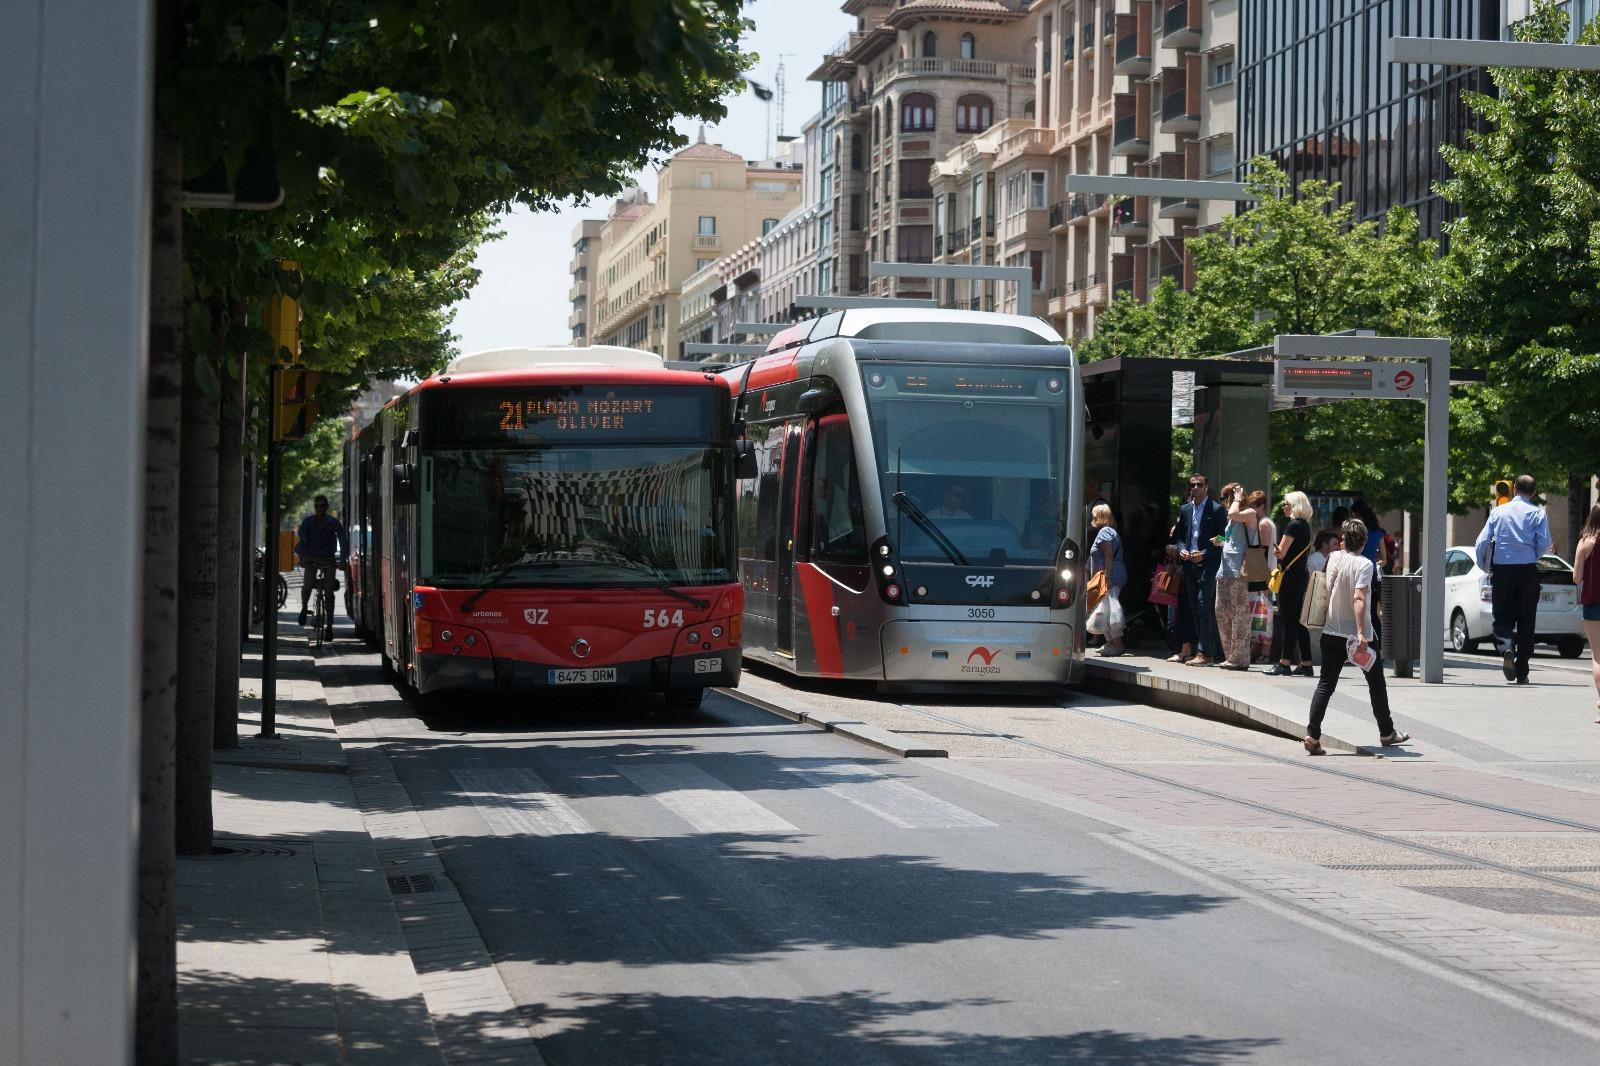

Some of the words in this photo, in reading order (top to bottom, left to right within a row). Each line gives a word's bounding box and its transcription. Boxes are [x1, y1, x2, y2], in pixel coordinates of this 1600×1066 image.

[526, 401, 579, 413] PLAZA
[587, 400, 653, 413] MOZART
[500, 401, 524, 429] 21
[556, 416, 624, 429] OLIVER
[965, 575, 995, 588] CAF
[643, 609, 684, 628] 564
[967, 608, 995, 619] 3050
[697, 660, 719, 672] SP
[961, 665, 1001, 676] zaragoza
[558, 670, 587, 682] 6475
[592, 669, 614, 681] DRM
